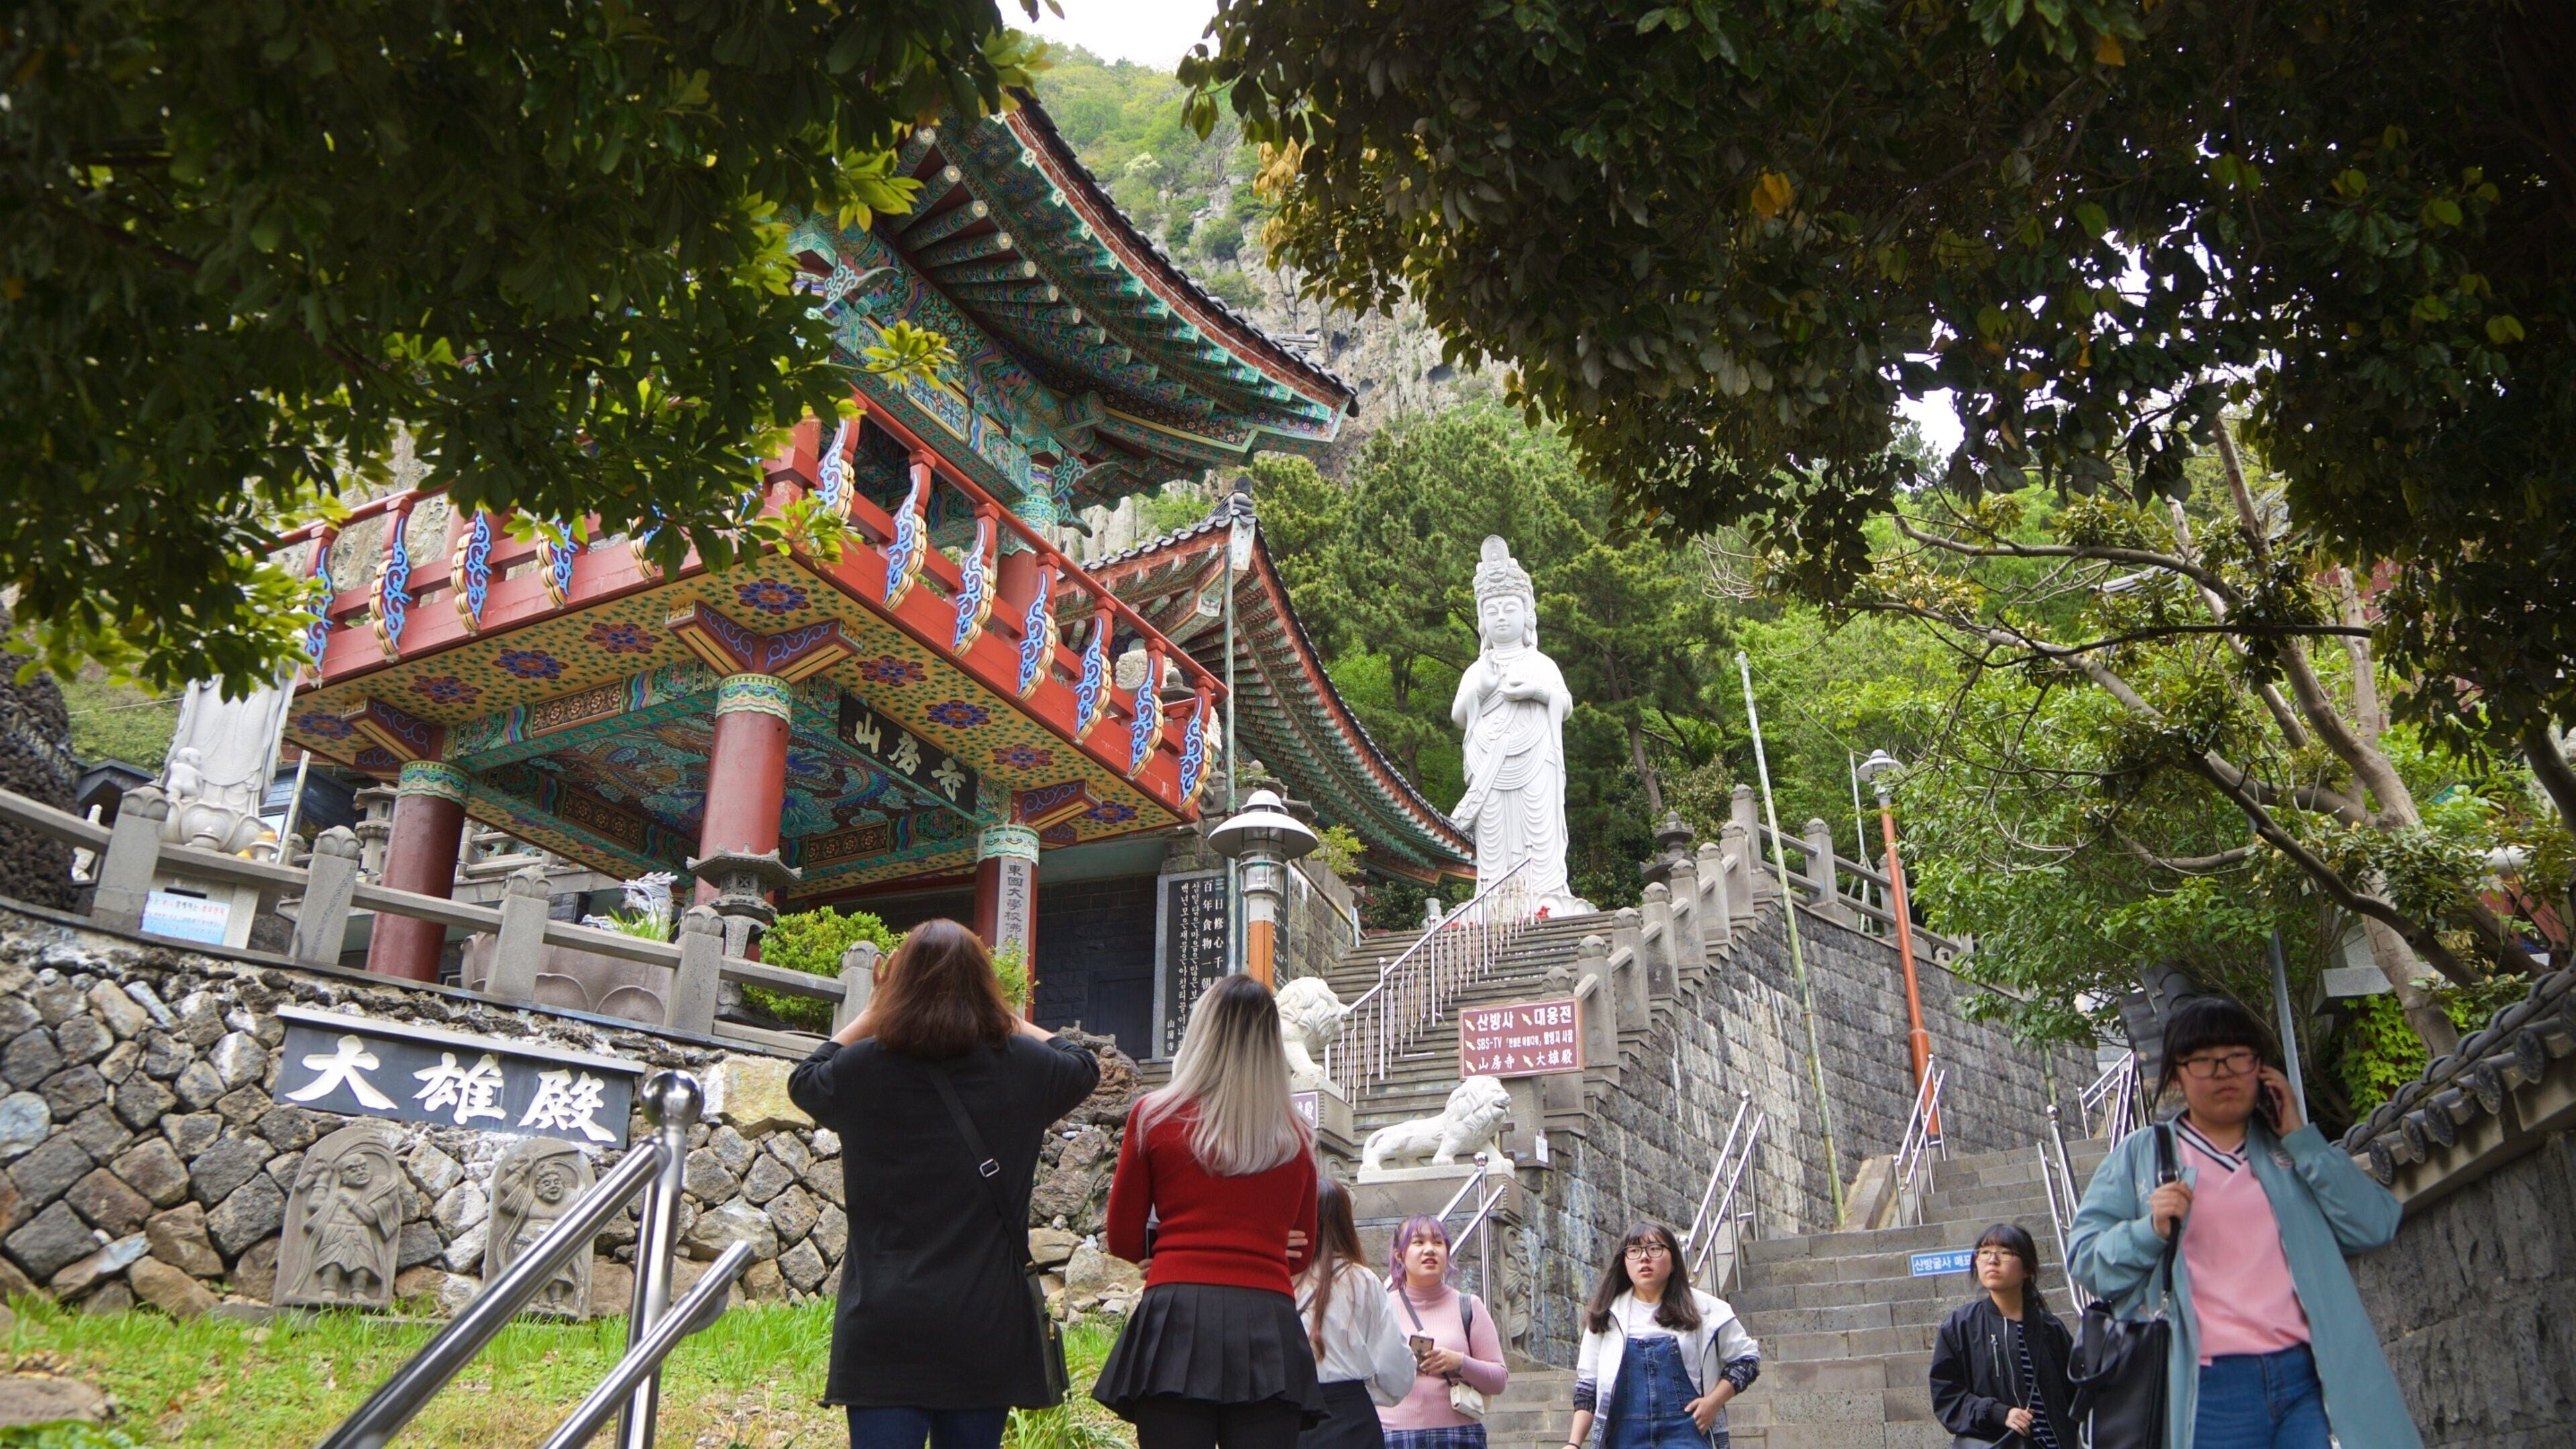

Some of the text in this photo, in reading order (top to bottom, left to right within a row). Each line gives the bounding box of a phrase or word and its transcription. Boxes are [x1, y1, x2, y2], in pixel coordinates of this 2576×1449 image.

[855, 712, 966, 802] 山房寺
[1477, 1006, 1572, 1032] 산방사 대웅전
[1477, 1036, 1502, 1051] SBS-TV
[1479, 1048, 1572, 1071] 山房寺 大雄殿
[284, 1034, 616, 1142] 大雄殿
[1915, 1256, 1951, 1271] 산방굴사
